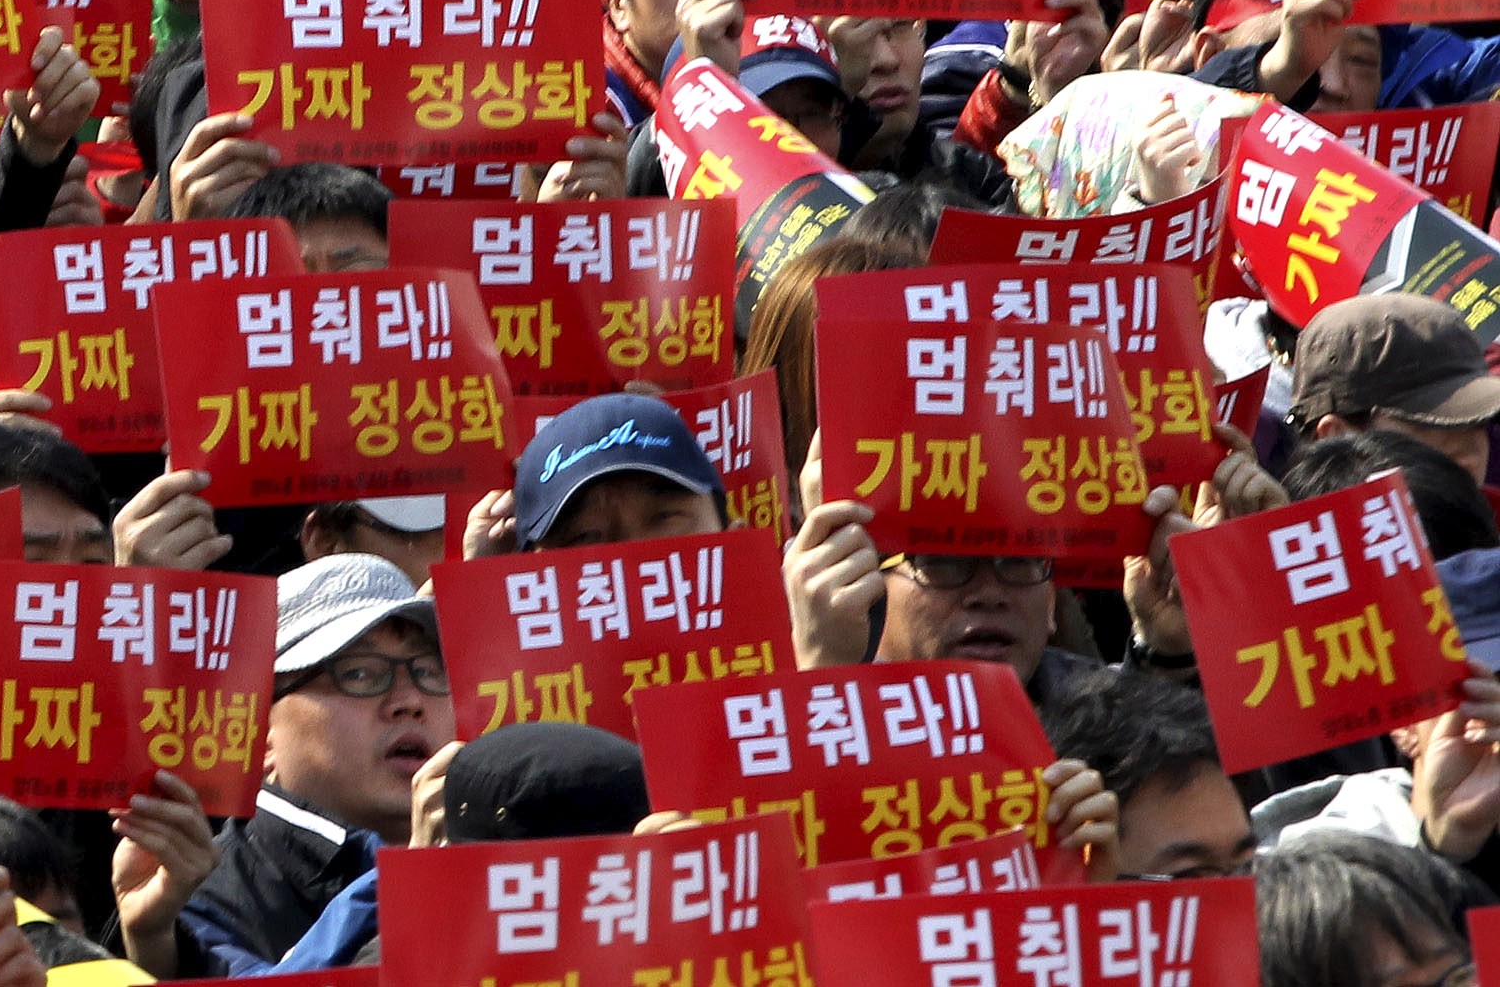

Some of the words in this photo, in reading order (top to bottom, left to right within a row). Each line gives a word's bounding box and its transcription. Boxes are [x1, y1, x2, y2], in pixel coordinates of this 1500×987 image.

[238, 64, 371, 129] 가짜
[408, 62, 591, 129] 정상화
[19, 330, 133, 402] 가짜
[600, 296, 720, 365] 정상화
[199, 385, 317, 462] 가짜
[350, 376, 503, 454] 정상화
[856, 434, 986, 510] 가짜
[1237, 606, 1393, 707] 가짜
[142, 689, 257, 772] 정상화
[863, 768, 1044, 858] 정상화
